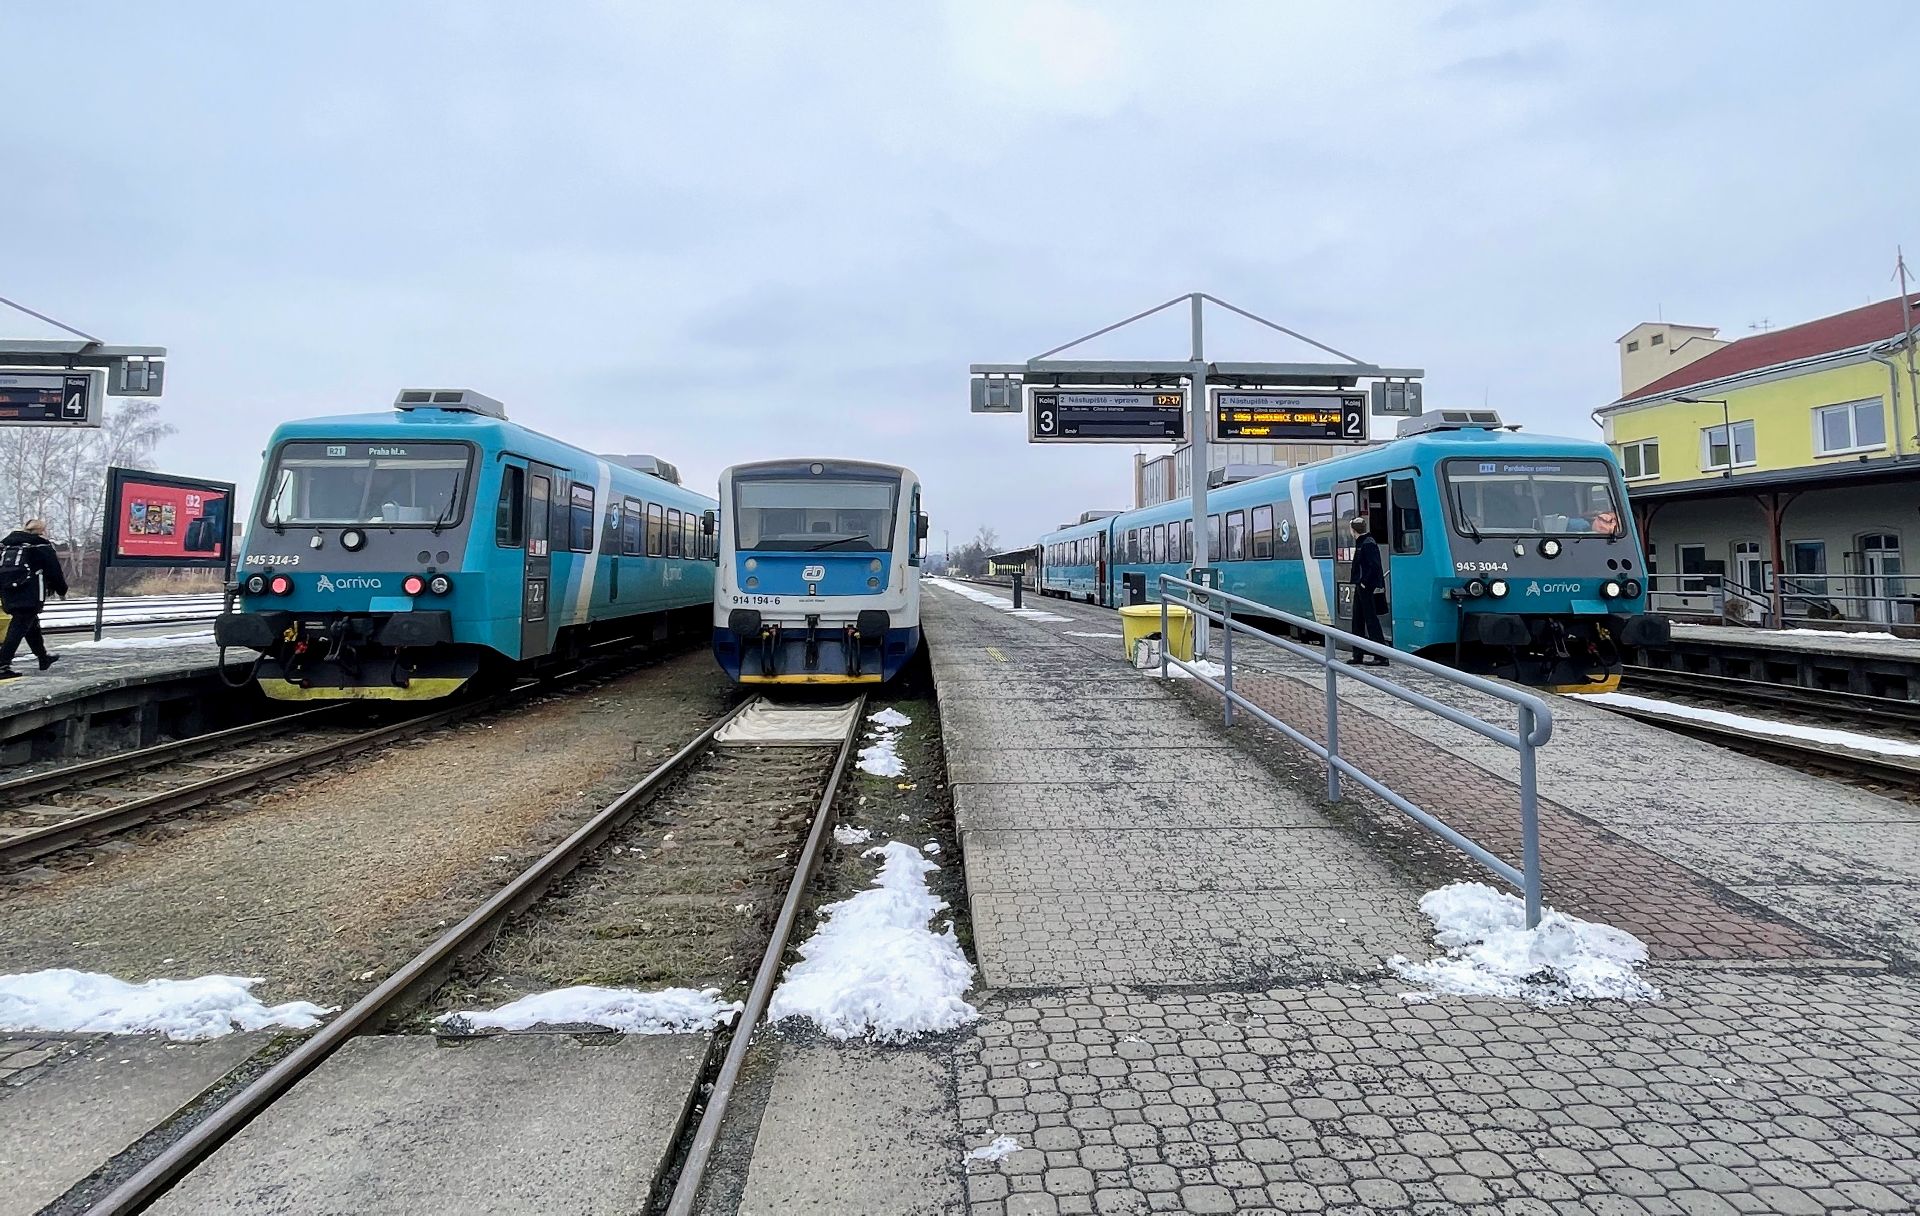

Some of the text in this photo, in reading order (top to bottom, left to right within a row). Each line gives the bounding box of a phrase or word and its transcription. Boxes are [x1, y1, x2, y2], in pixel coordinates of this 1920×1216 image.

[67, 393, 81, 414] 4
[1039, 397, 1056, 405] Kolej
[1040, 410, 1054, 432] 3
[1346, 412, 1360, 434] 2
[368, 447, 390, 456] Praha
[245, 555, 300, 565] 945 314-3
[1456, 562, 1509, 572] 945 304-4
[335, 576, 382, 589] arriva
[1543, 582, 1581, 594] arriva
[533, 583, 539, 602] 2
[1345, 586, 1351, 603] 2
[732, 595, 781, 605] 914 194-6
